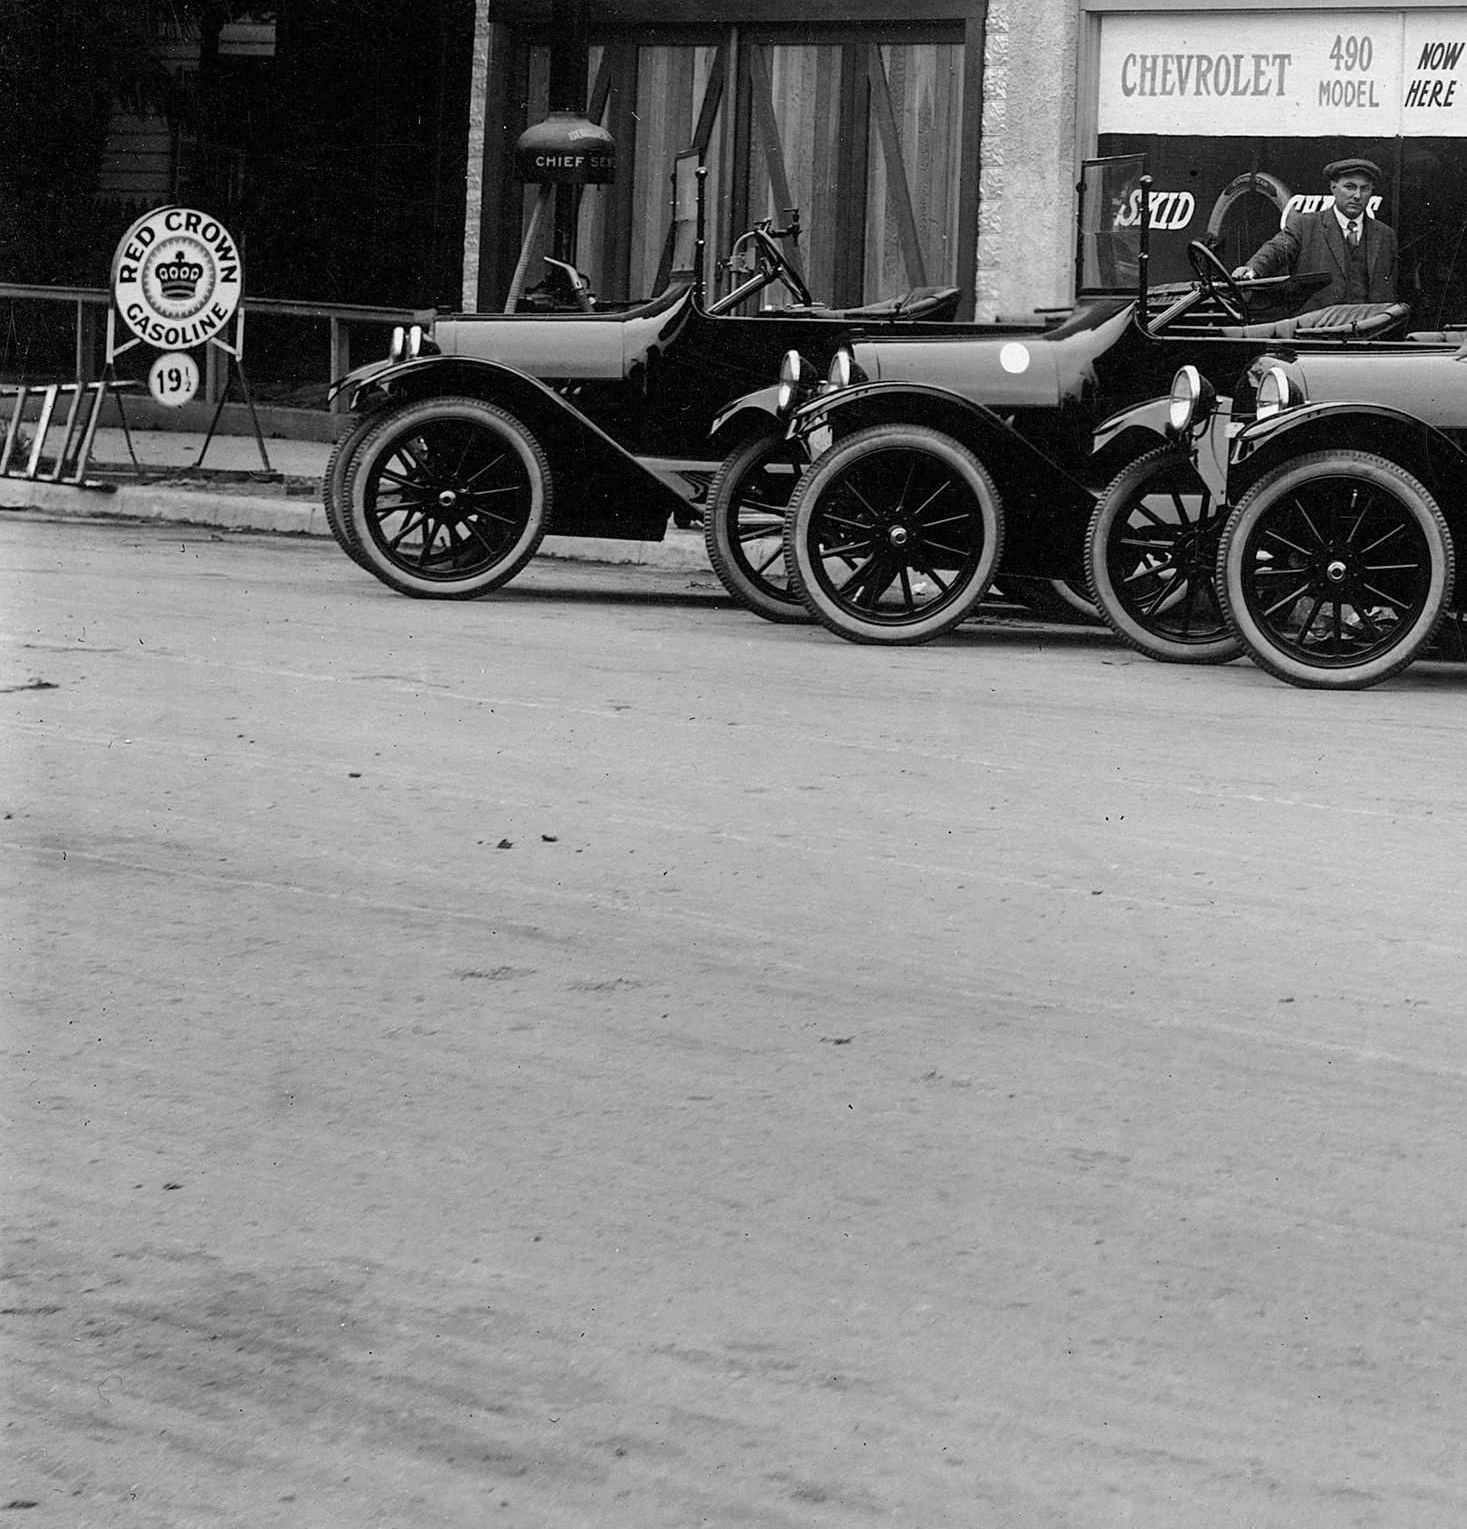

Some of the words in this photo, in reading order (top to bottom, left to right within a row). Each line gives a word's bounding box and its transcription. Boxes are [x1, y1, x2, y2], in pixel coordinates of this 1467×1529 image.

[1328, 34, 1374, 73] 490
[1416, 41, 1466, 71] NOW
[1121, 52, 1293, 98] CHEVROLET
[1318, 79, 1381, 109] MODEL
[1403, 78, 1459, 109] HERE
[535, 156, 585, 168] CHIEF
[119, 225, 156, 284] RED
[164, 211, 238, 284] CROWN
[126, 302, 229, 345] GASOLINE
